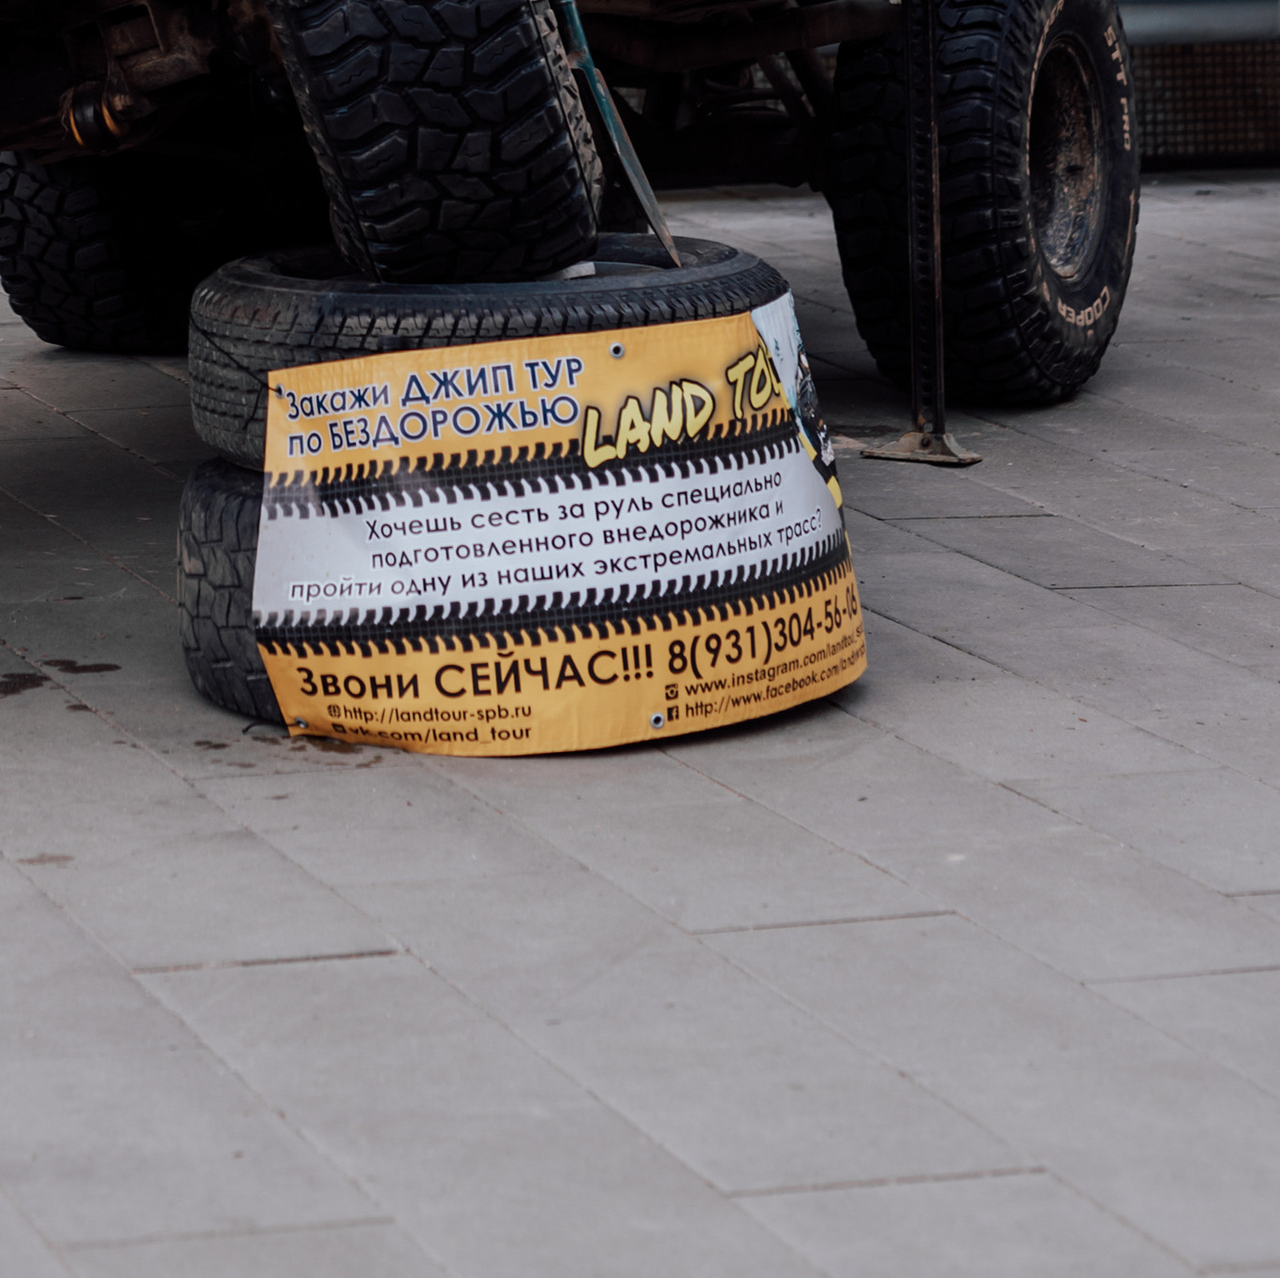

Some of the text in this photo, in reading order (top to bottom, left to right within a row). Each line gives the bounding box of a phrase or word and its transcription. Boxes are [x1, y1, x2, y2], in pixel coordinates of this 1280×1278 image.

[1103, 24, 1128, 86] STT
[1057, 285, 1111, 328] COOPER
[286, 356, 584, 420] Закажи ДЖИП ТУР
[288, 394, 581, 457] по БЕЗДОРОЖЬЮ
[582, 378, 716, 468] LAND
[366, 470, 783, 540] Хочешь сесть за руль специально
[371, 500, 784, 569] подготовленного внедорожника и
[290, 508, 823, 602] пройти одну из наших экстремальных трасс?
[295, 582, 859, 700] Звони СЕЙЧАС!!! 8(931)304-56-06
[343, 704, 532, 725] http://landtour-spb.ru
[349, 724, 532, 744] vk.com/land_tour
